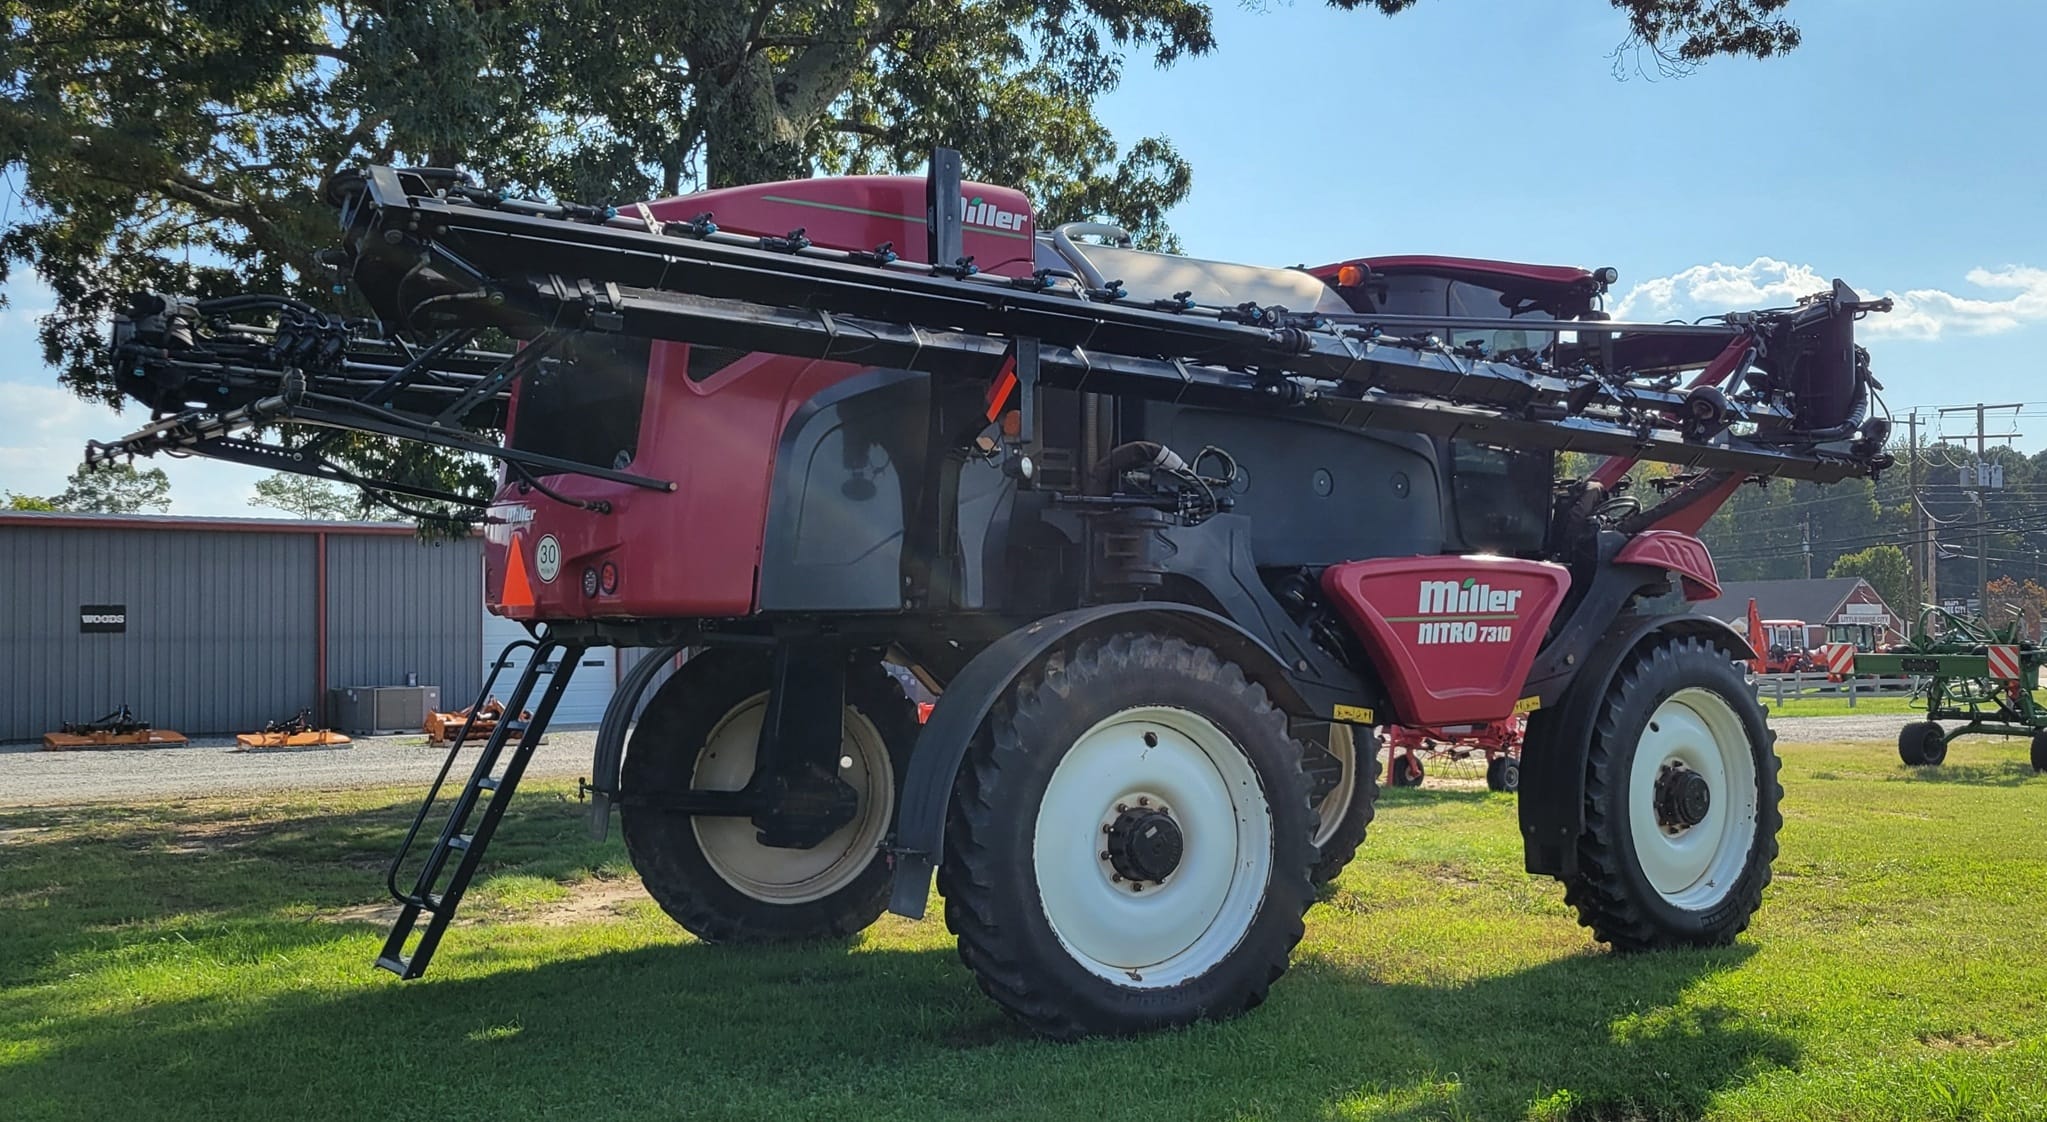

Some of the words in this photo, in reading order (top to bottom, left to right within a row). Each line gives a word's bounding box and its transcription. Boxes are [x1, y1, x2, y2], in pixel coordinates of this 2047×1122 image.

[540, 544, 556, 564] 30
[1418, 578, 1522, 614] Miller
[81, 614, 125, 624] WOODS
[1877, 615, 1888, 623] CITY
[1418, 622, 1477, 644] NITRO
[1479, 626, 1512, 643] 7310
